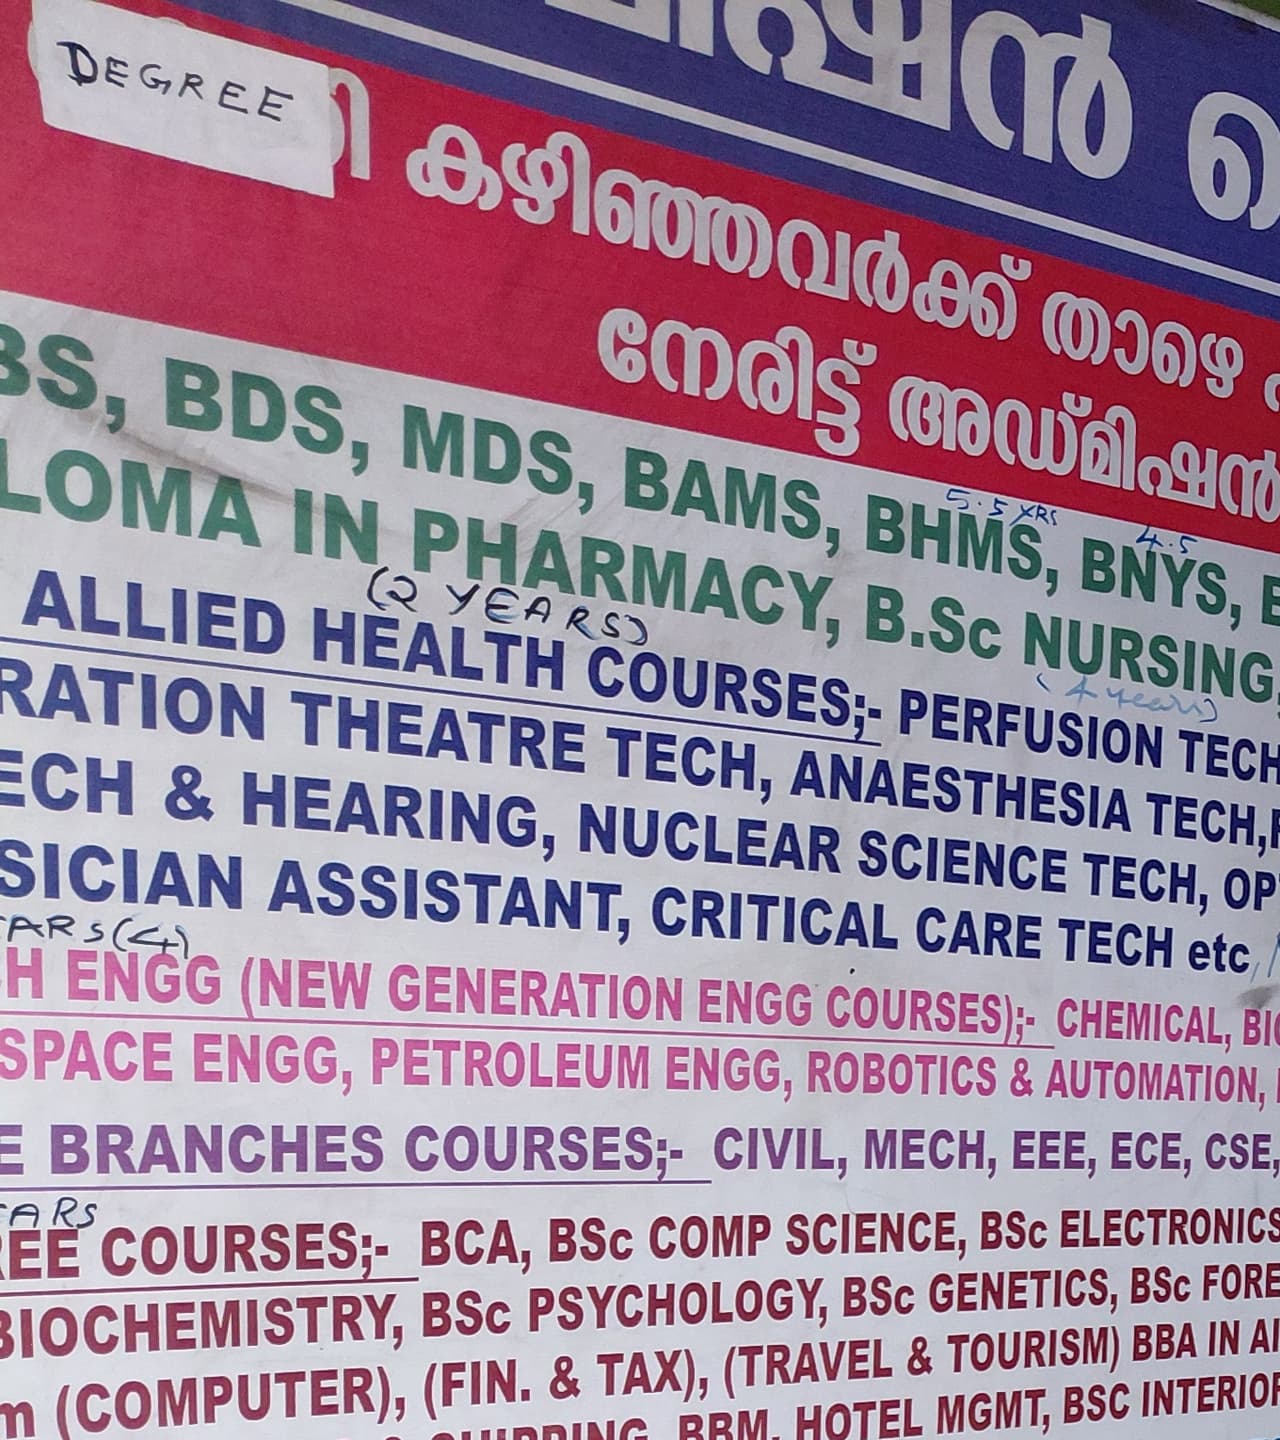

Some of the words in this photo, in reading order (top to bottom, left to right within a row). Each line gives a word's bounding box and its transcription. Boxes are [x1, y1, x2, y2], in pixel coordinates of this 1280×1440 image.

[56, 41, 294, 122] DEGREE
[406, 122, 1032, 342] കഴിഞ്ഞവർക്ക്
[1042, 289, 1245, 399] താഴെ
[597, 305, 878, 457] നേരിട്ട്
[164, 355, 369, 476] BDS,
[402, 402, 594, 516] MDS,
[623, 445, 840, 559] BAMS,
[865, 492, 1059, 598] BHMS,
[1080, 535, 1242, 632] BNYS,
[292, 487, 390, 573] IN
[400, 507, 840, 649] PHARMACY,
[864, 582, 1002, 660] B.Sc
[19, 568, 285, 655] ALLIED
[311, 606, 565, 692] HEALTH
[586, 645, 882, 747] COURSES;-
[898, 688, 1163, 769] PERFUSION
[289, 689, 586, 774] THEATRE
[605, 725, 773, 805] TECH,
[788, 748, 1132, 833] ANAESTHESIA
[163, 763, 215, 822] &
[241, 769, 556, 863] HEARING,
[578, 801, 842, 874] NUCLEAR
[856, 828, 1068, 894] SCIENCE
[1081, 851, 1209, 917] TECH,
[266, 858, 631, 946] ASSISTANT,
[650, 885, 899, 951] CRITICAL
[915, 905, 1042, 960] CARE
[1056, 916, 1174, 969] TECH
[192, 1031, 353, 1096] ENGG,
[371, 1036, 650, 1089] PETROLEUM
[665, 1045, 792, 1103] ENGG,
[806, 1049, 997, 1097] ROBOTICS
[1009, 1056, 1034, 1097] &
[1043, 1058, 1266, 1113] AUTOMATION,
[50, 1123, 384, 1175] BRANCHES
[404, 1124, 683, 1185] COURSES;-
[712, 1126, 848, 1181] CIVIL,
[863, 1127, 997, 1180] MECH,
[1011, 1129, 1097, 1180] EEE,
[1109, 1130, 1192, 1180] ECE,
[1204, 1131, 1280, 1179] CSE,
[421, 1289, 512, 1338] BSc
[528, 1276, 828, 1333] PSYCHOLOGY,
[841, 1274, 916, 1318] BSc
[927, 1267, 1118, 1315] GENETICS,
[1129, 1264, 1191, 1305] BSc
[935, 1387, 1051, 1436] MGMT,
[1062, 1381, 1131, 1424] BSC
